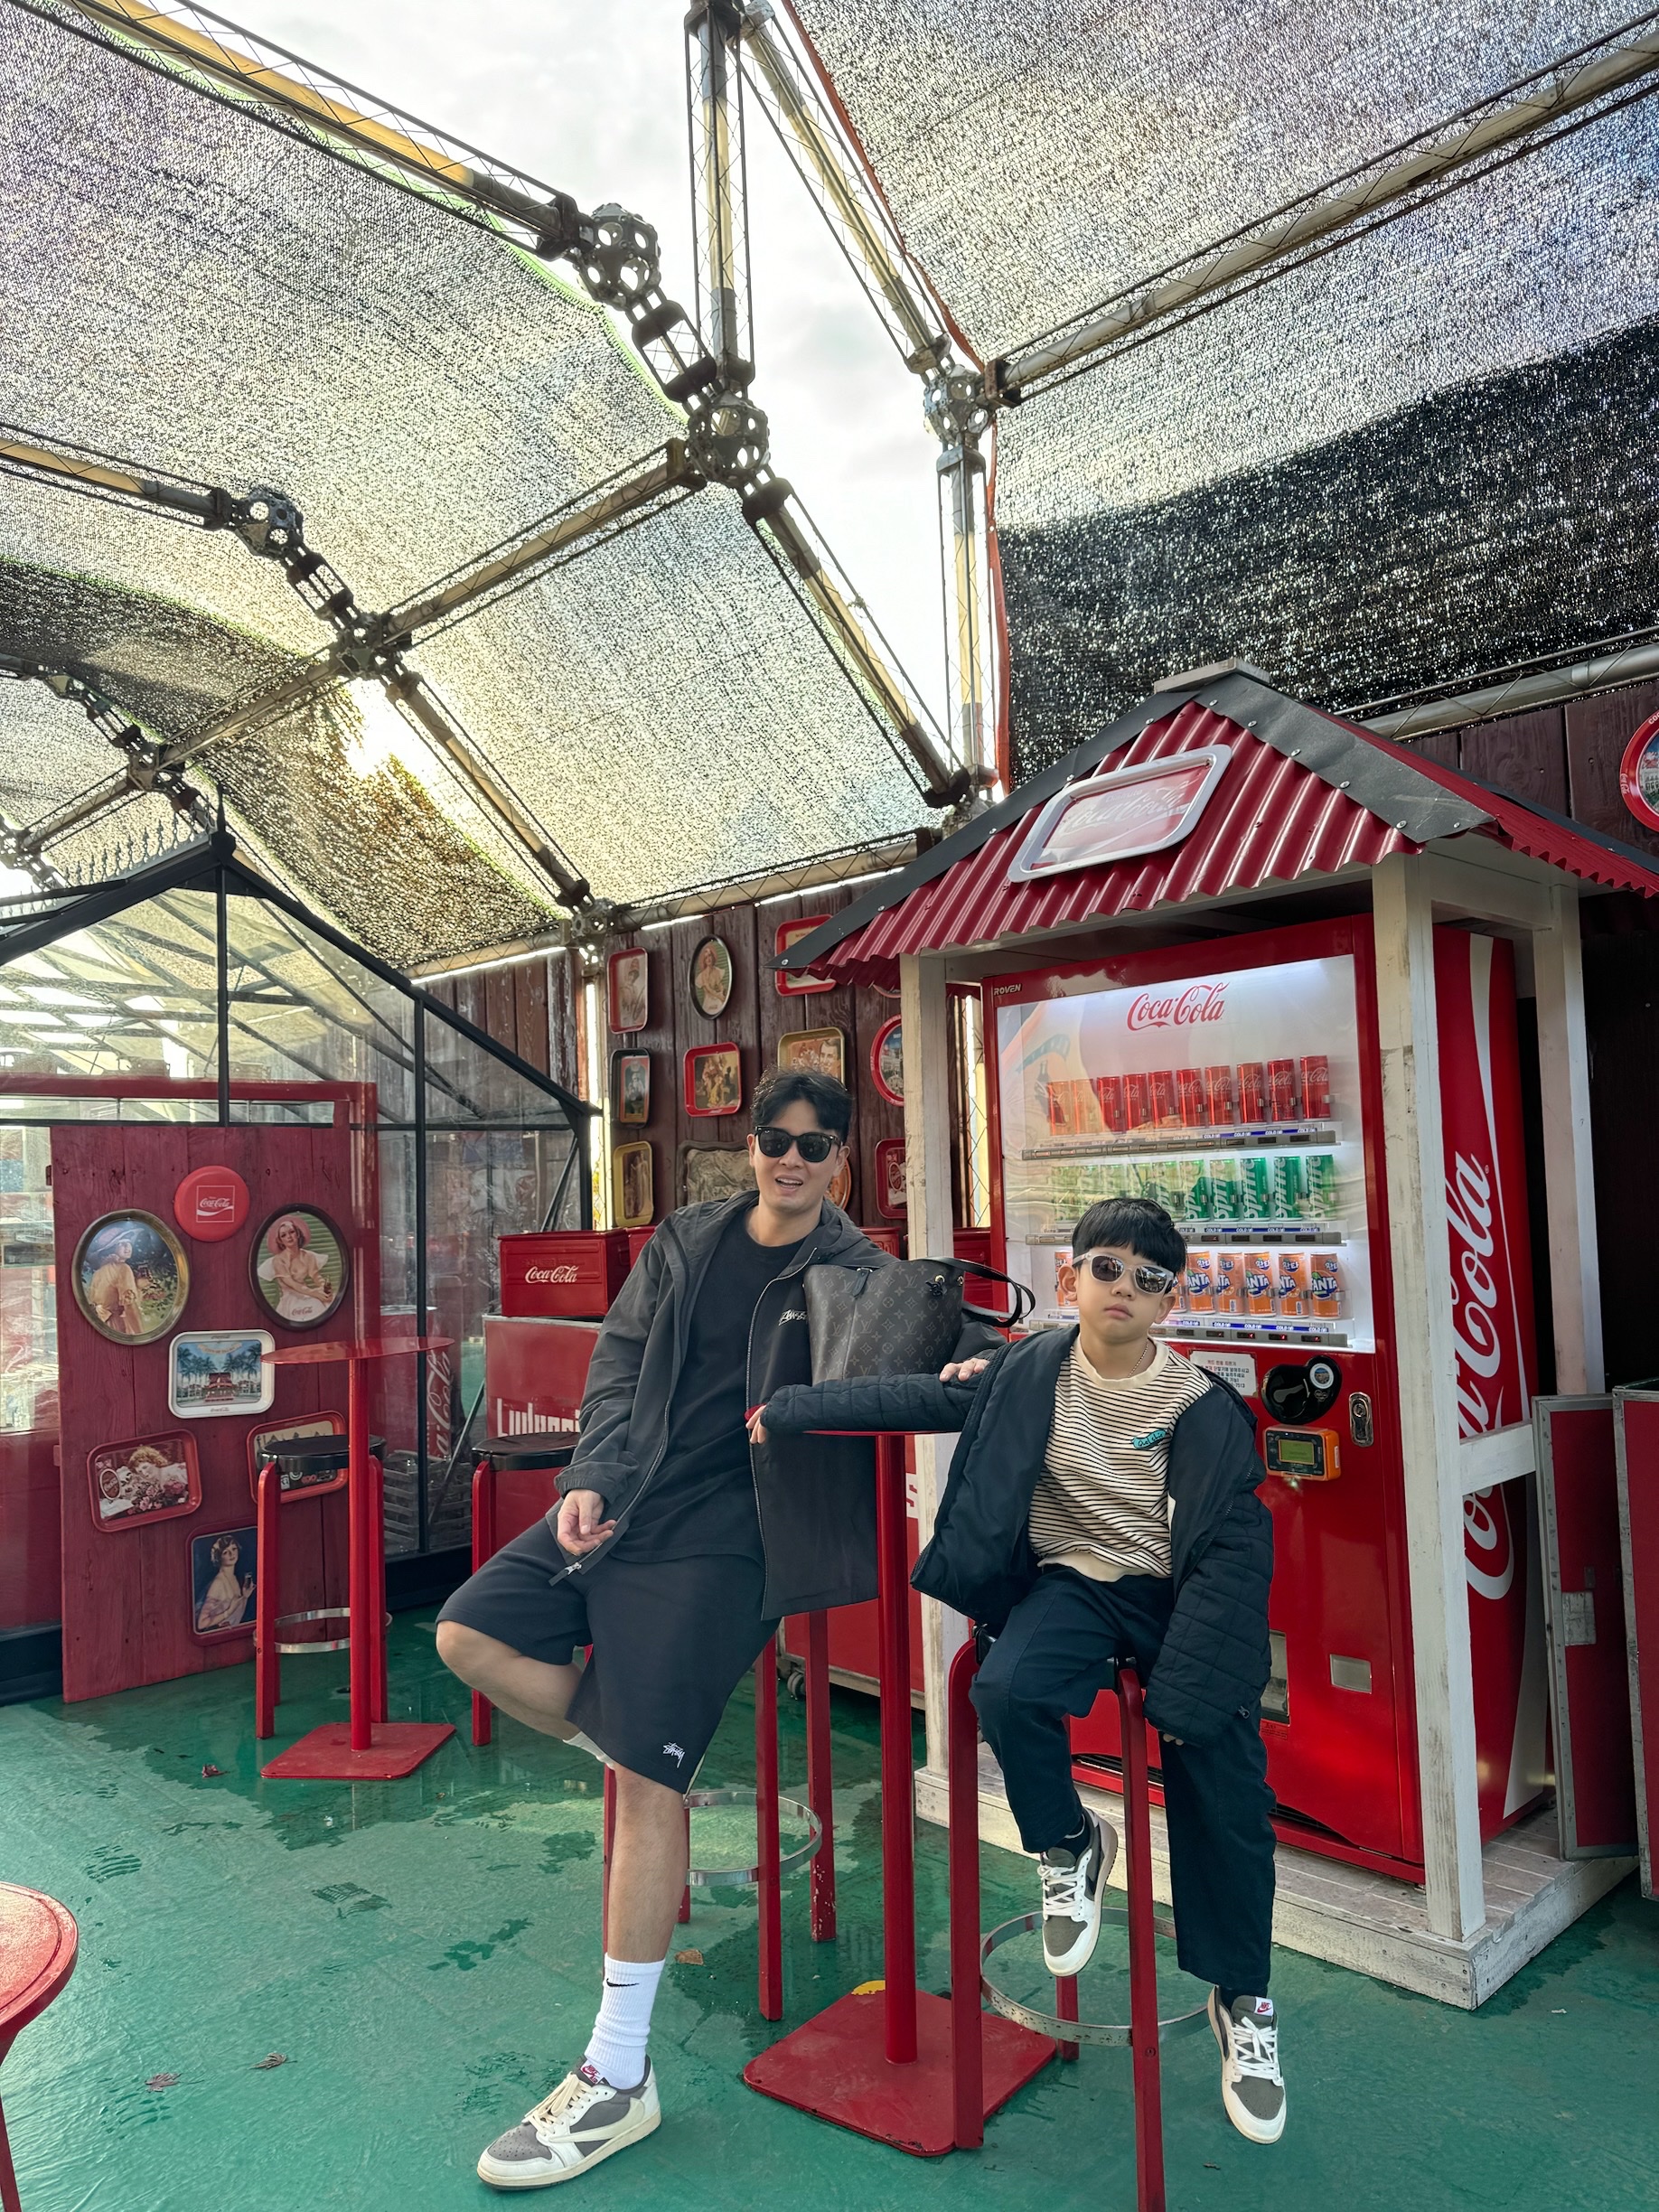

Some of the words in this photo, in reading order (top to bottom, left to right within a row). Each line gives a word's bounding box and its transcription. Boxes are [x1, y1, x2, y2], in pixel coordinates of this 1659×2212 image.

[994, 983, 1022, 996] ROVEN
[1127, 981, 1230, 1031] Coca-Cola
[200, 1197, 230, 1209] Coca-Cola
[524, 1265, 579, 1284] Coca-Cola
[1187, 1273, 1210, 1289] ANTA
[1246, 1274, 1269, 1290] ANTA
